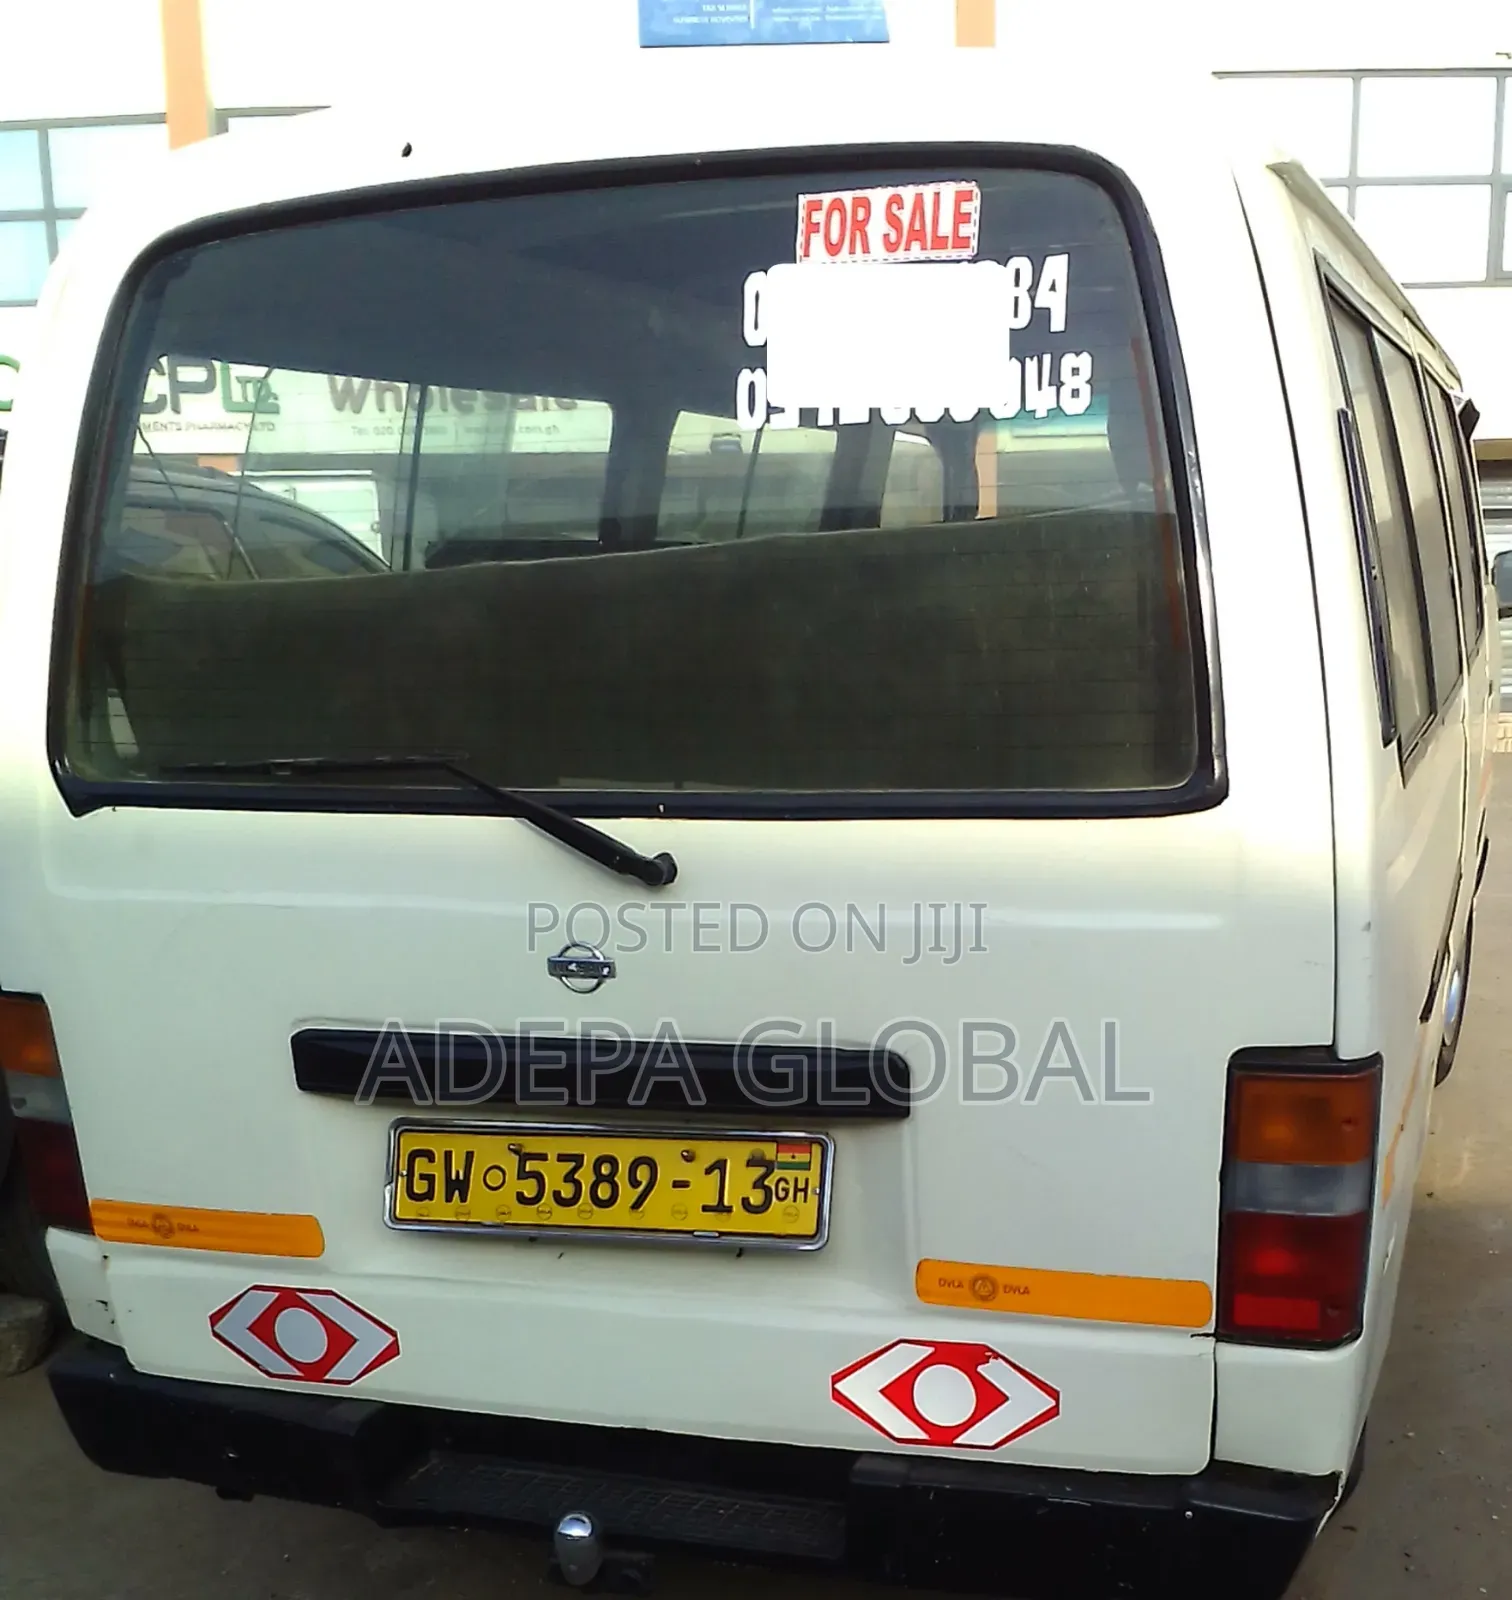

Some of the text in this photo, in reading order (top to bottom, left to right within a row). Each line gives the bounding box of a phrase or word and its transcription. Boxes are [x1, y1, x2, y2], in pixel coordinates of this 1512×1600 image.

[802, 189, 975, 258] FOR SALE
[405, 1148, 475, 1203] GW
[773, 1175, 810, 1203] GH
[938, 1277, 1030, 1295] DVLA DVLA
